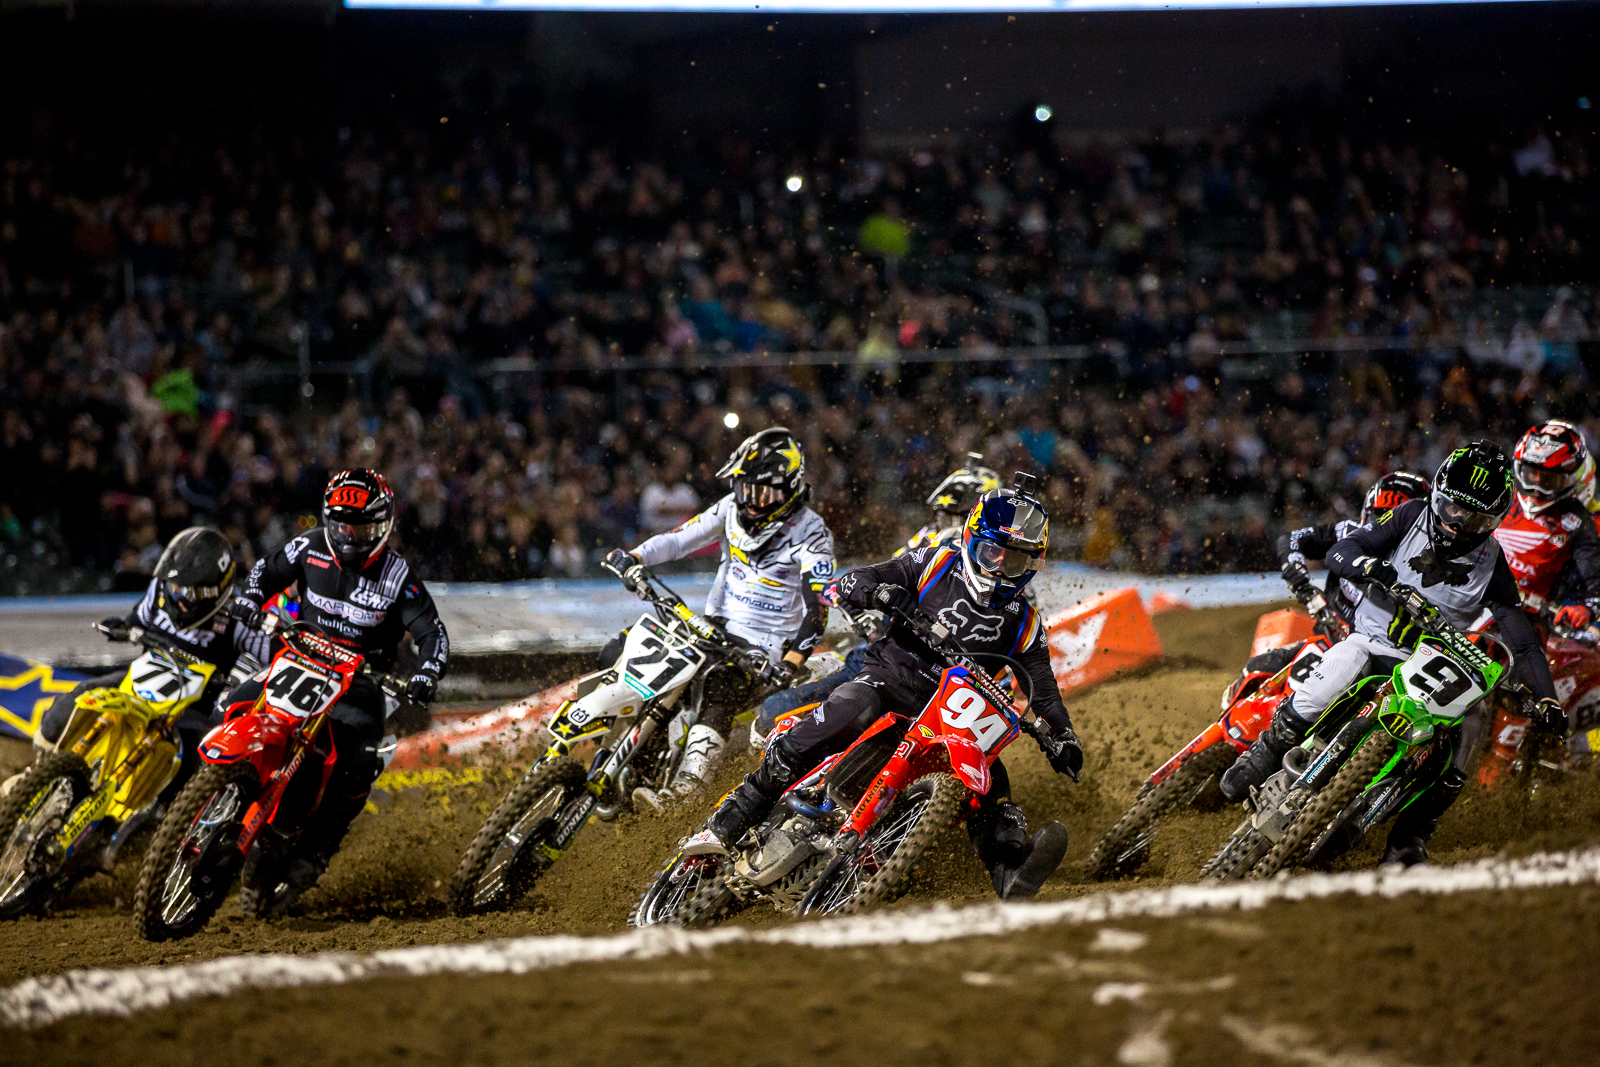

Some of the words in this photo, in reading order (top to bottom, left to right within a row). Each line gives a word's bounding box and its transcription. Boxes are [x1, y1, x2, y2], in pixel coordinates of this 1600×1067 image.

[1444, 486, 1488, 511] MONSTER
[307, 549, 334, 561] DUNLOP
[625, 636, 691, 693] 21
[1408, 655, 1473, 708] 9
[266, 665, 336, 714] 46
[979, 684, 1004, 711] MONSTER
[939, 686, 1010, 753] 94
[69, 791, 108, 840] DUNLOP
[238, 790, 275, 847] DUNLOP
[556, 795, 593, 845] DUNLOP
[855, 777, 884, 818] DUNLOP
